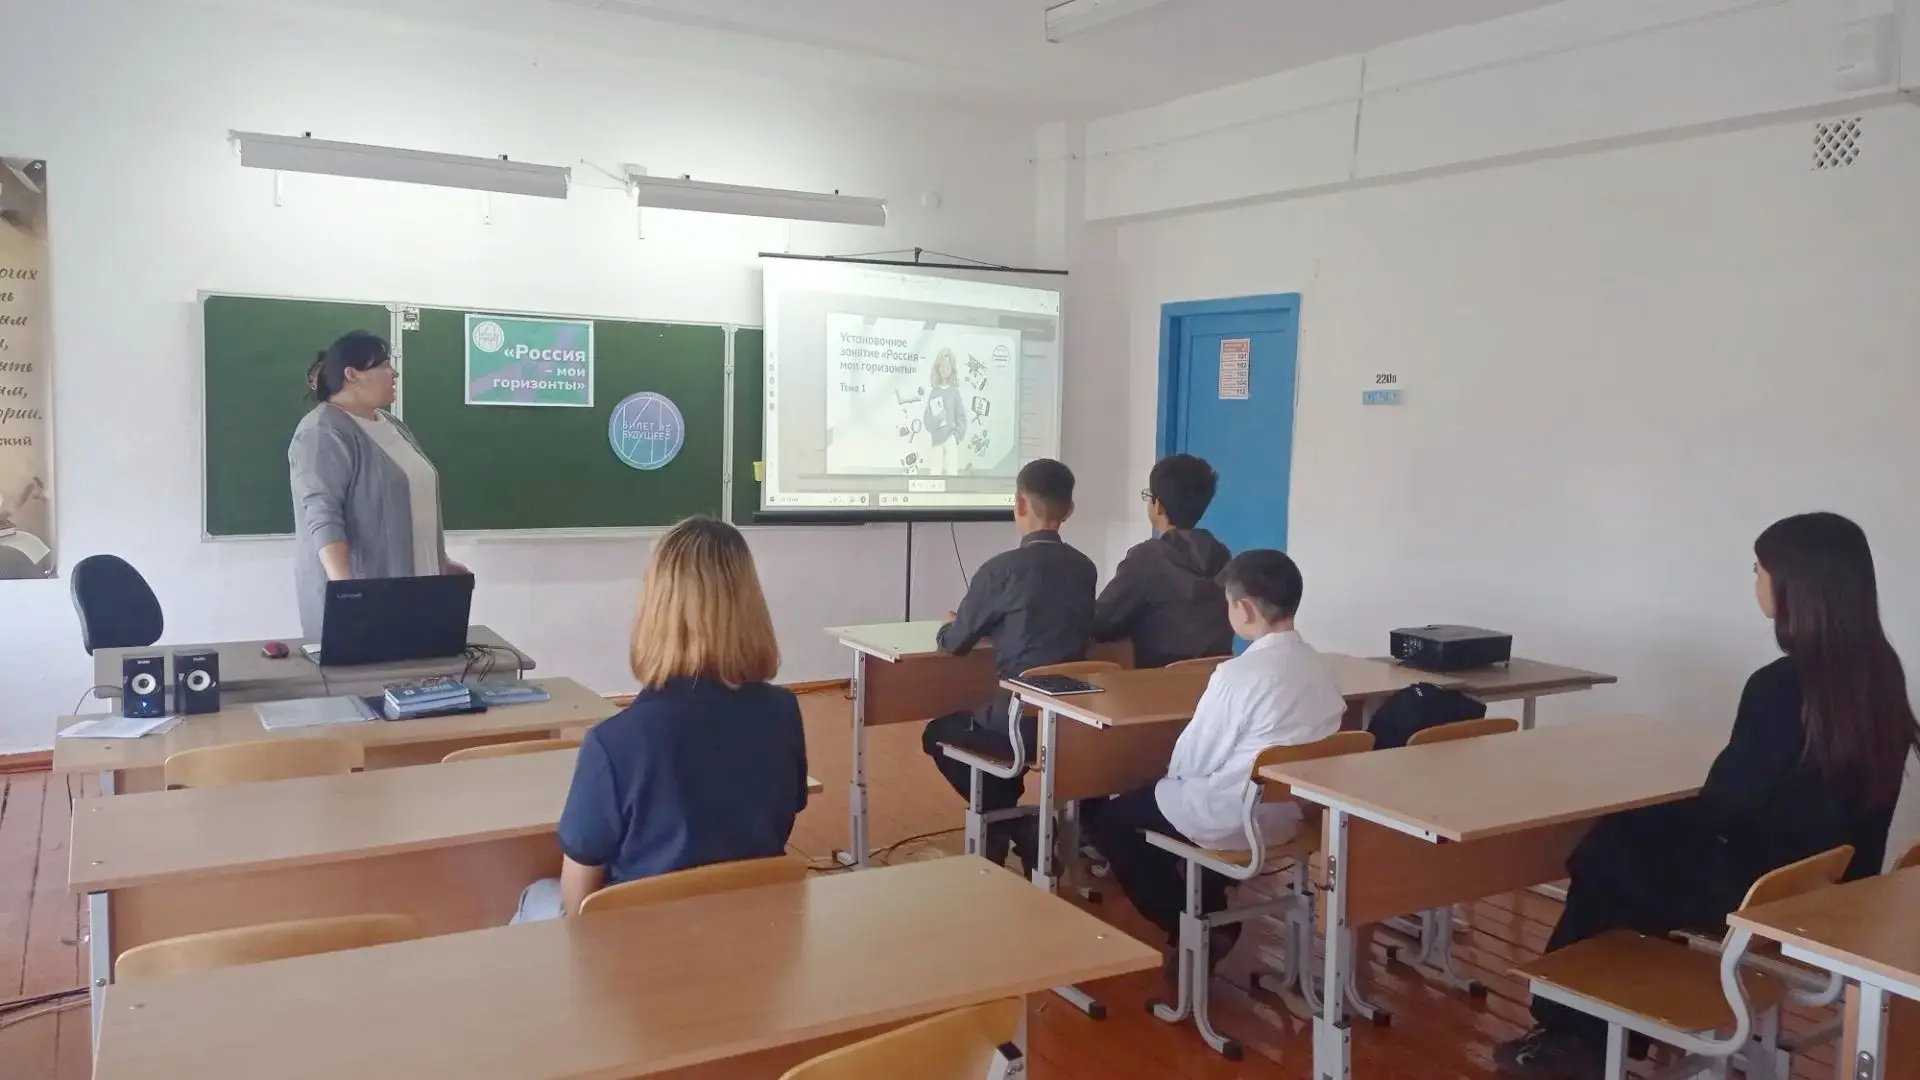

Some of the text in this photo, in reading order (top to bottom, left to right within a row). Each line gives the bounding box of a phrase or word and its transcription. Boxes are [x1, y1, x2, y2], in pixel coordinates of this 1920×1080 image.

[840, 332, 908, 348] Установочное
[504, 344, 586, 362] «Россия
[840, 348, 881, 359] занятие
[882, 349, 919, 362] «Россия
[556, 367, 586, 377] мои
[840, 361, 917, 375] мои горизонты»
[493, 378, 586, 392] горизонты»
[840, 382, 866, 393] Тема 1
